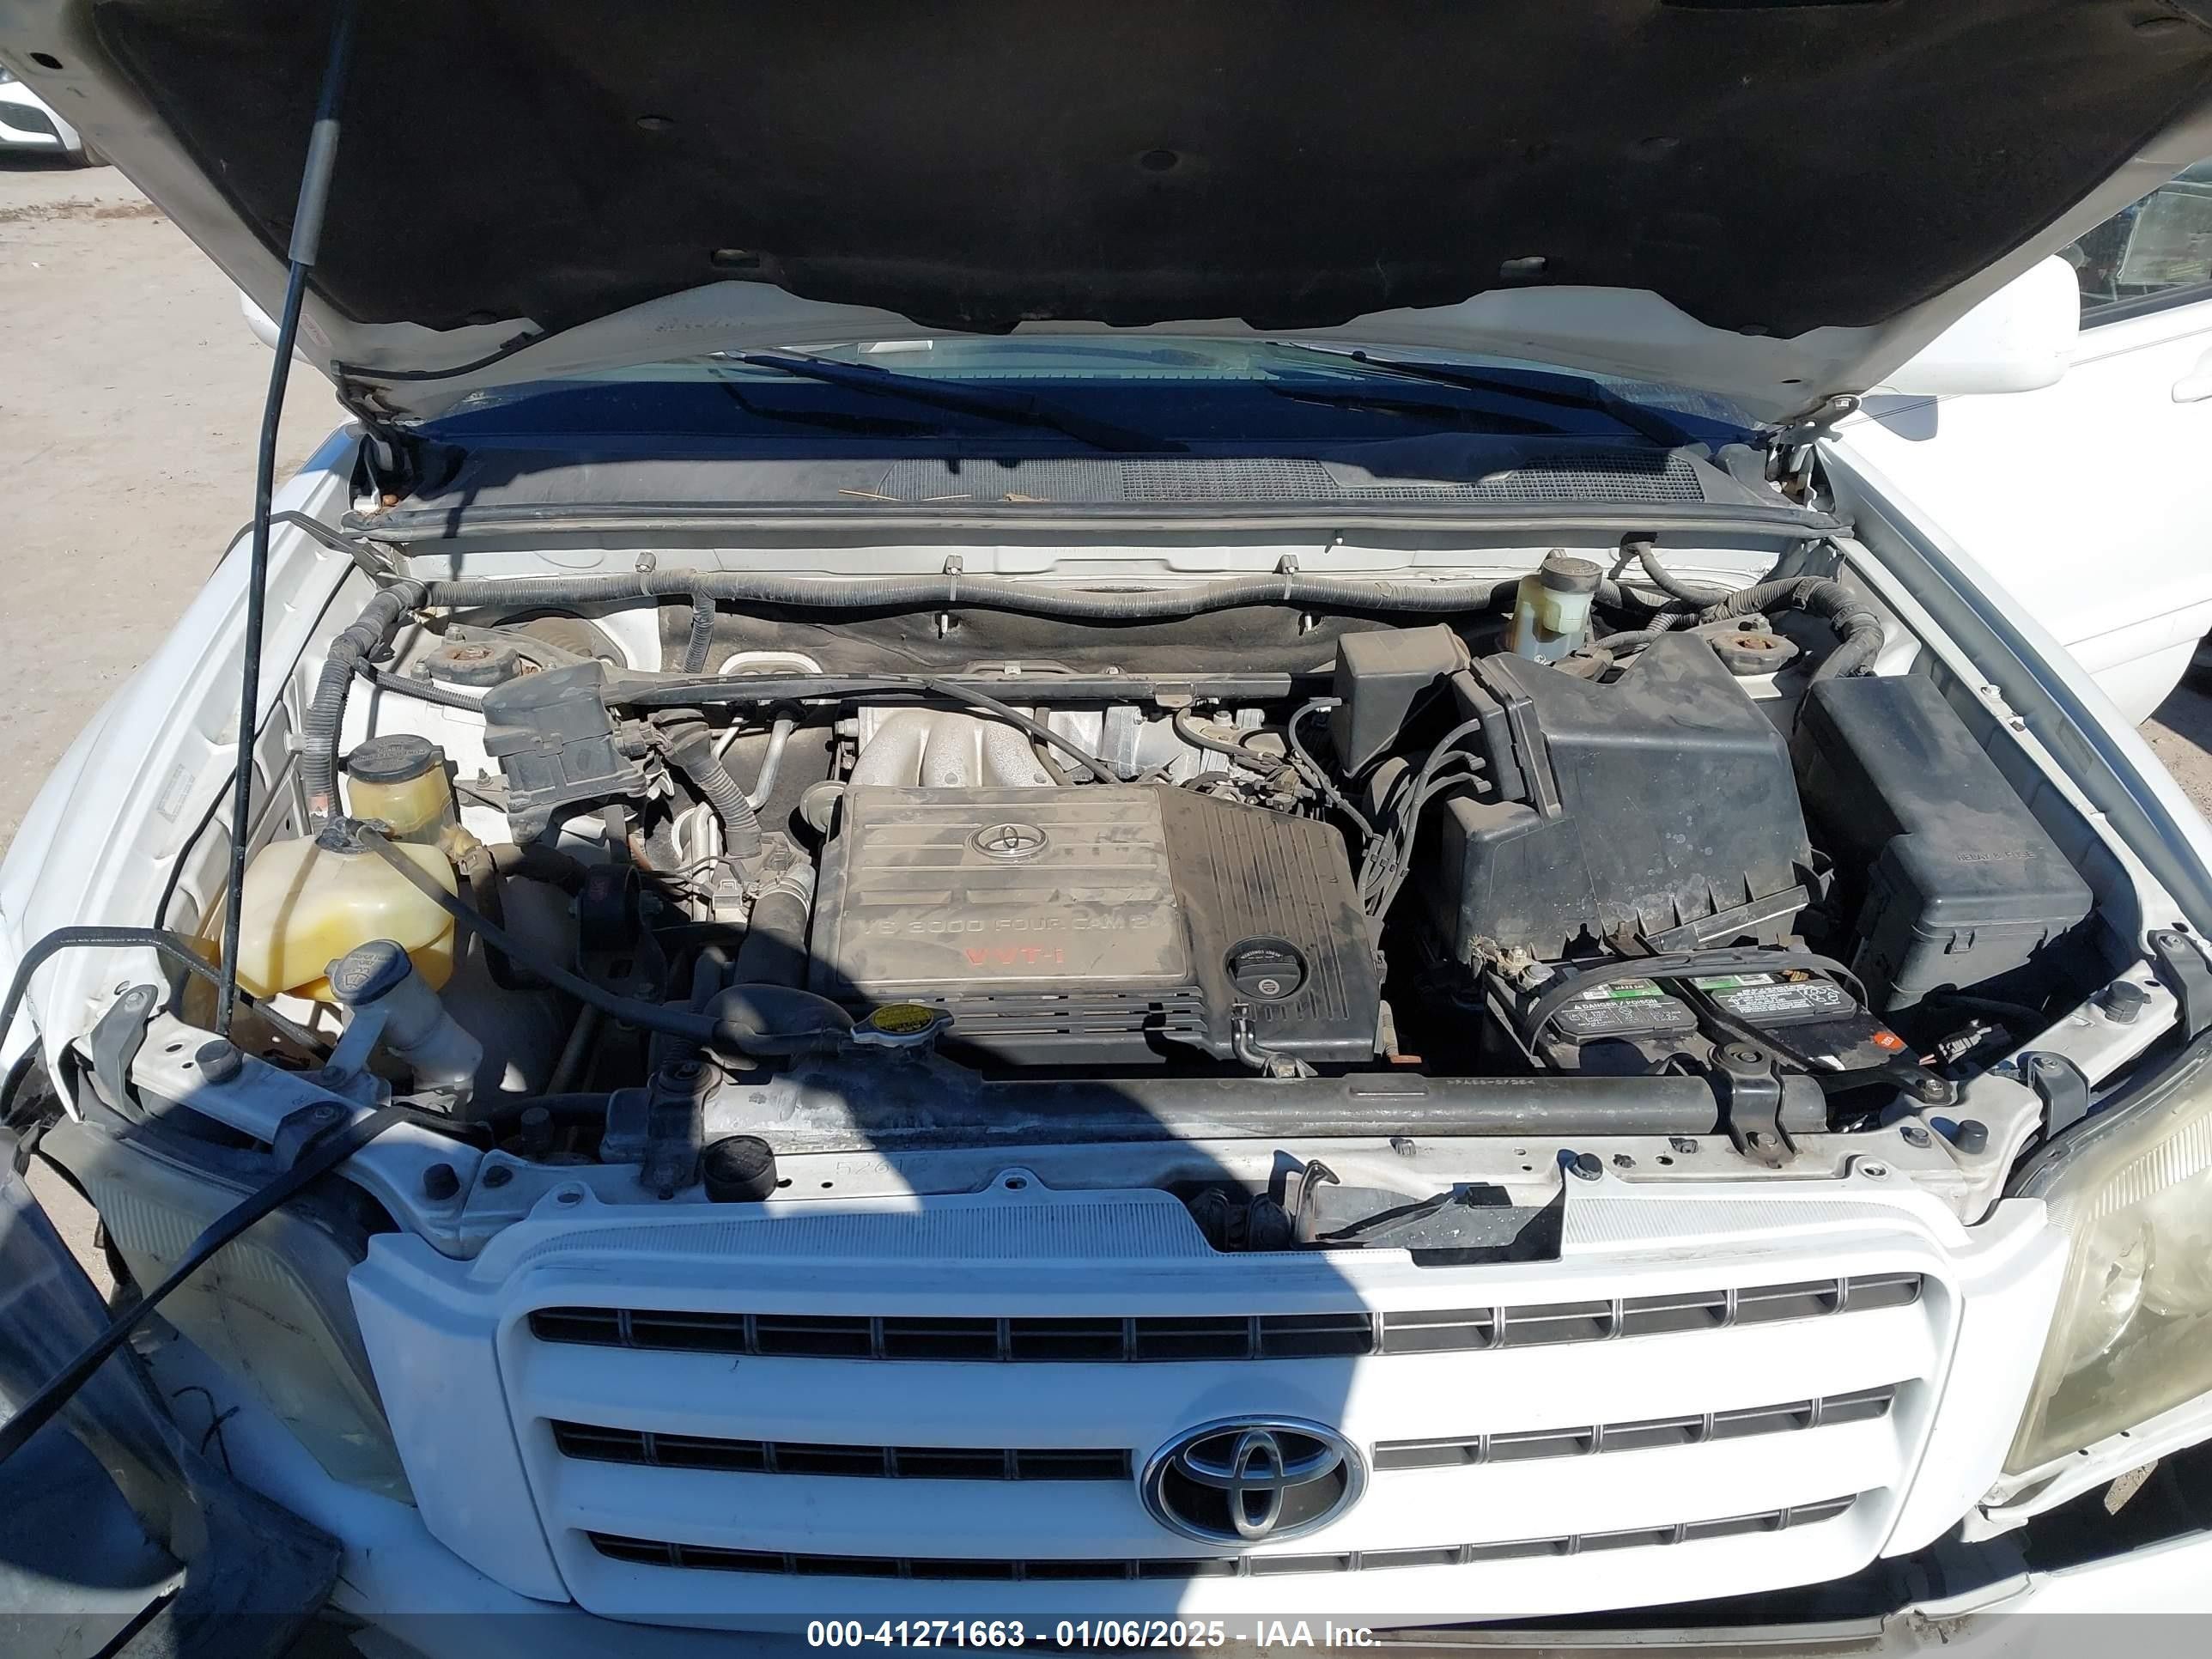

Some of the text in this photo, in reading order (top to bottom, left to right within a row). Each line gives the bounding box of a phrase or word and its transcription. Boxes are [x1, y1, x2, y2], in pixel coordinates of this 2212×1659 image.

[2005, 850, 2036, 860] FUSE
[908, 918, 984, 933] 3000
[994, 917, 1066, 933] FOUR
[1072, 915, 1124, 931] CAM
[1582, 1001, 1619, 1011] DANGER
[1626, 998, 1658, 1006] POISON
